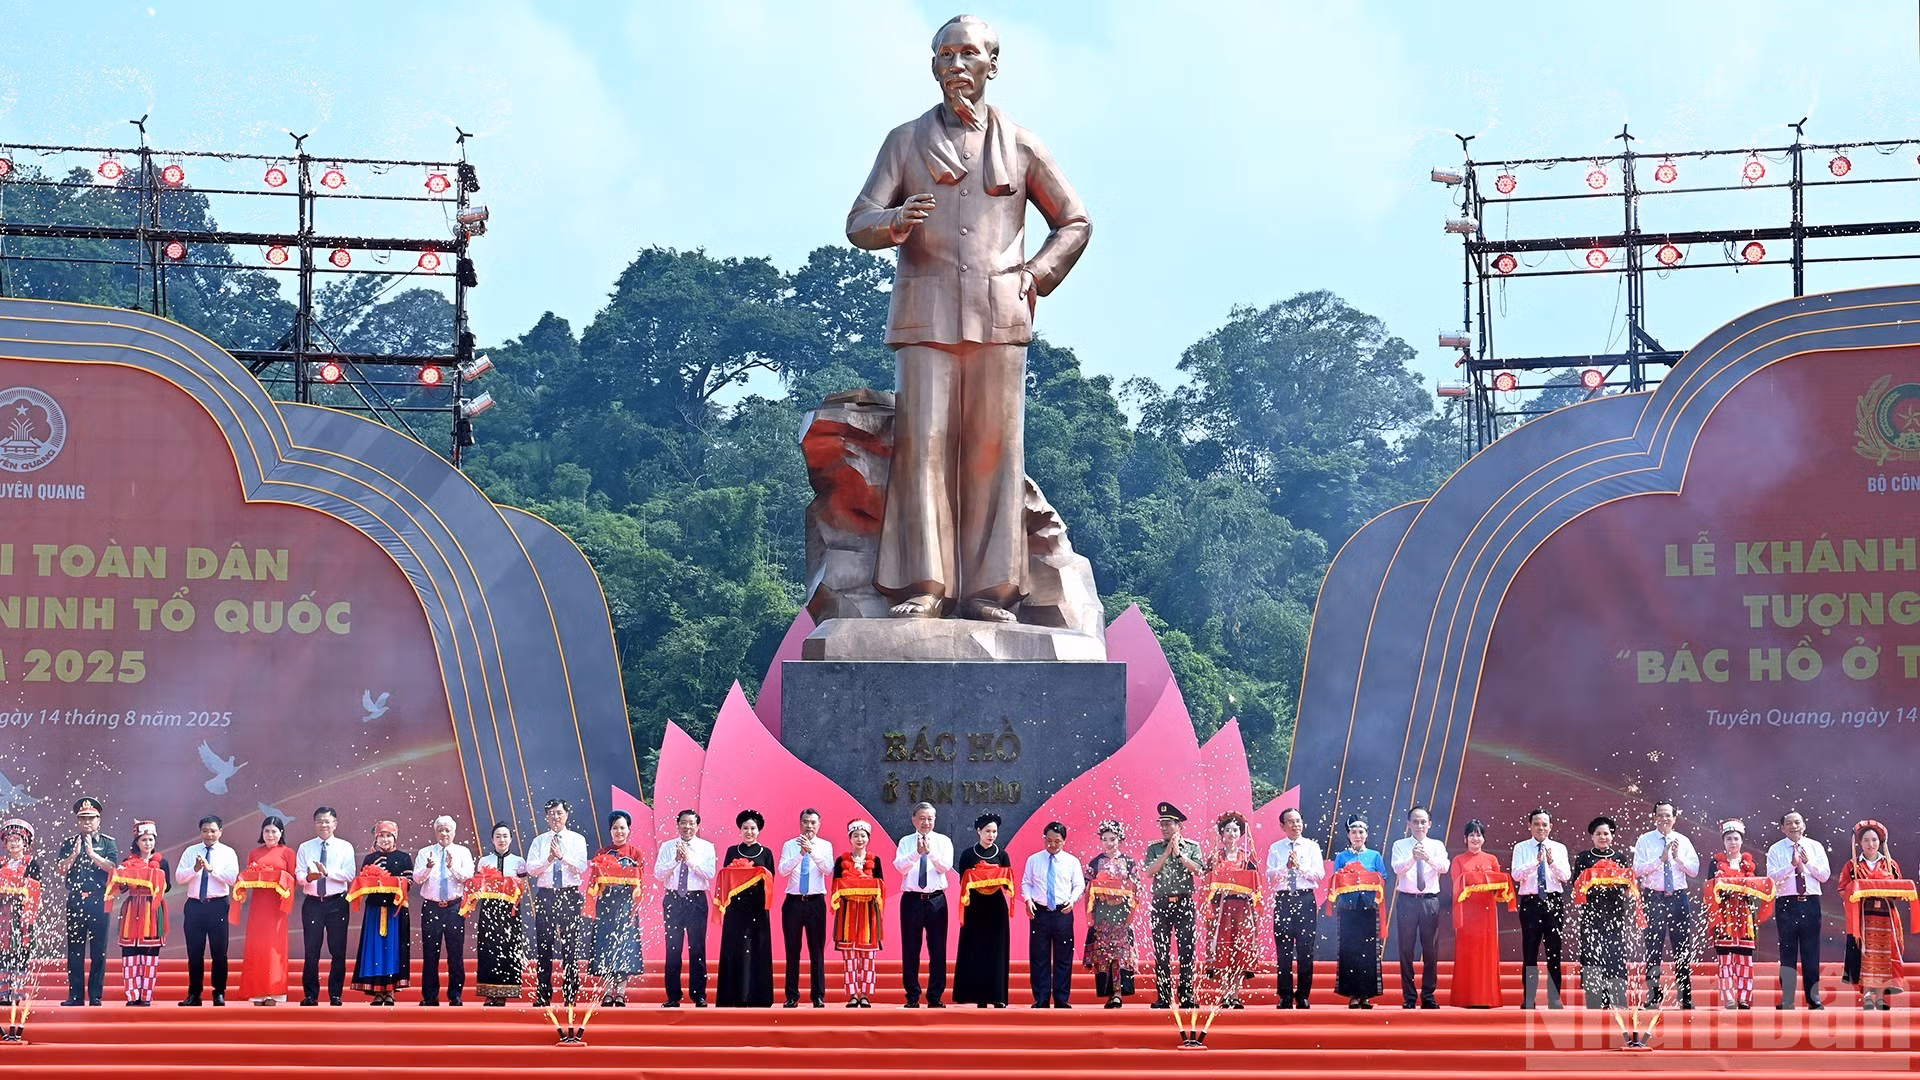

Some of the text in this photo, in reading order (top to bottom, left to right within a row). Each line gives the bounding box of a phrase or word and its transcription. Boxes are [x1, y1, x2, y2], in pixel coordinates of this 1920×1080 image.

[21, 448, 56, 471] QUANG
[37, 484, 86, 500] QUANG
[1868, 473, 1887, 495] BỘ
[33, 538, 167, 578] TOÀN
[186, 541, 289, 581] DÂN
[1665, 530, 1916, 577] LỄ KHÁNH
[133, 586, 196, 632] TỔ
[214, 590, 351, 634] QUỐC
[1743, 590, 1920, 636] TƯỢNG
[22, 648, 147, 684] 2025
[1749, 635, 1823, 682] HỒ
[1841, 636, 1882, 681] Ở
[39, 709, 61, 726] 14
[64, 709, 120, 730] tháng
[124, 710, 137, 727] 8
[140, 710, 182, 727] năm
[185, 711, 232, 728] 2025
[1706, 706, 1918, 730] Tuyên Quang, ngày 14
[882, 714, 1022, 763] BÁC HỒ
[906, 774, 953, 804] TÂN
[961, 775, 1022, 804] TRÀO
